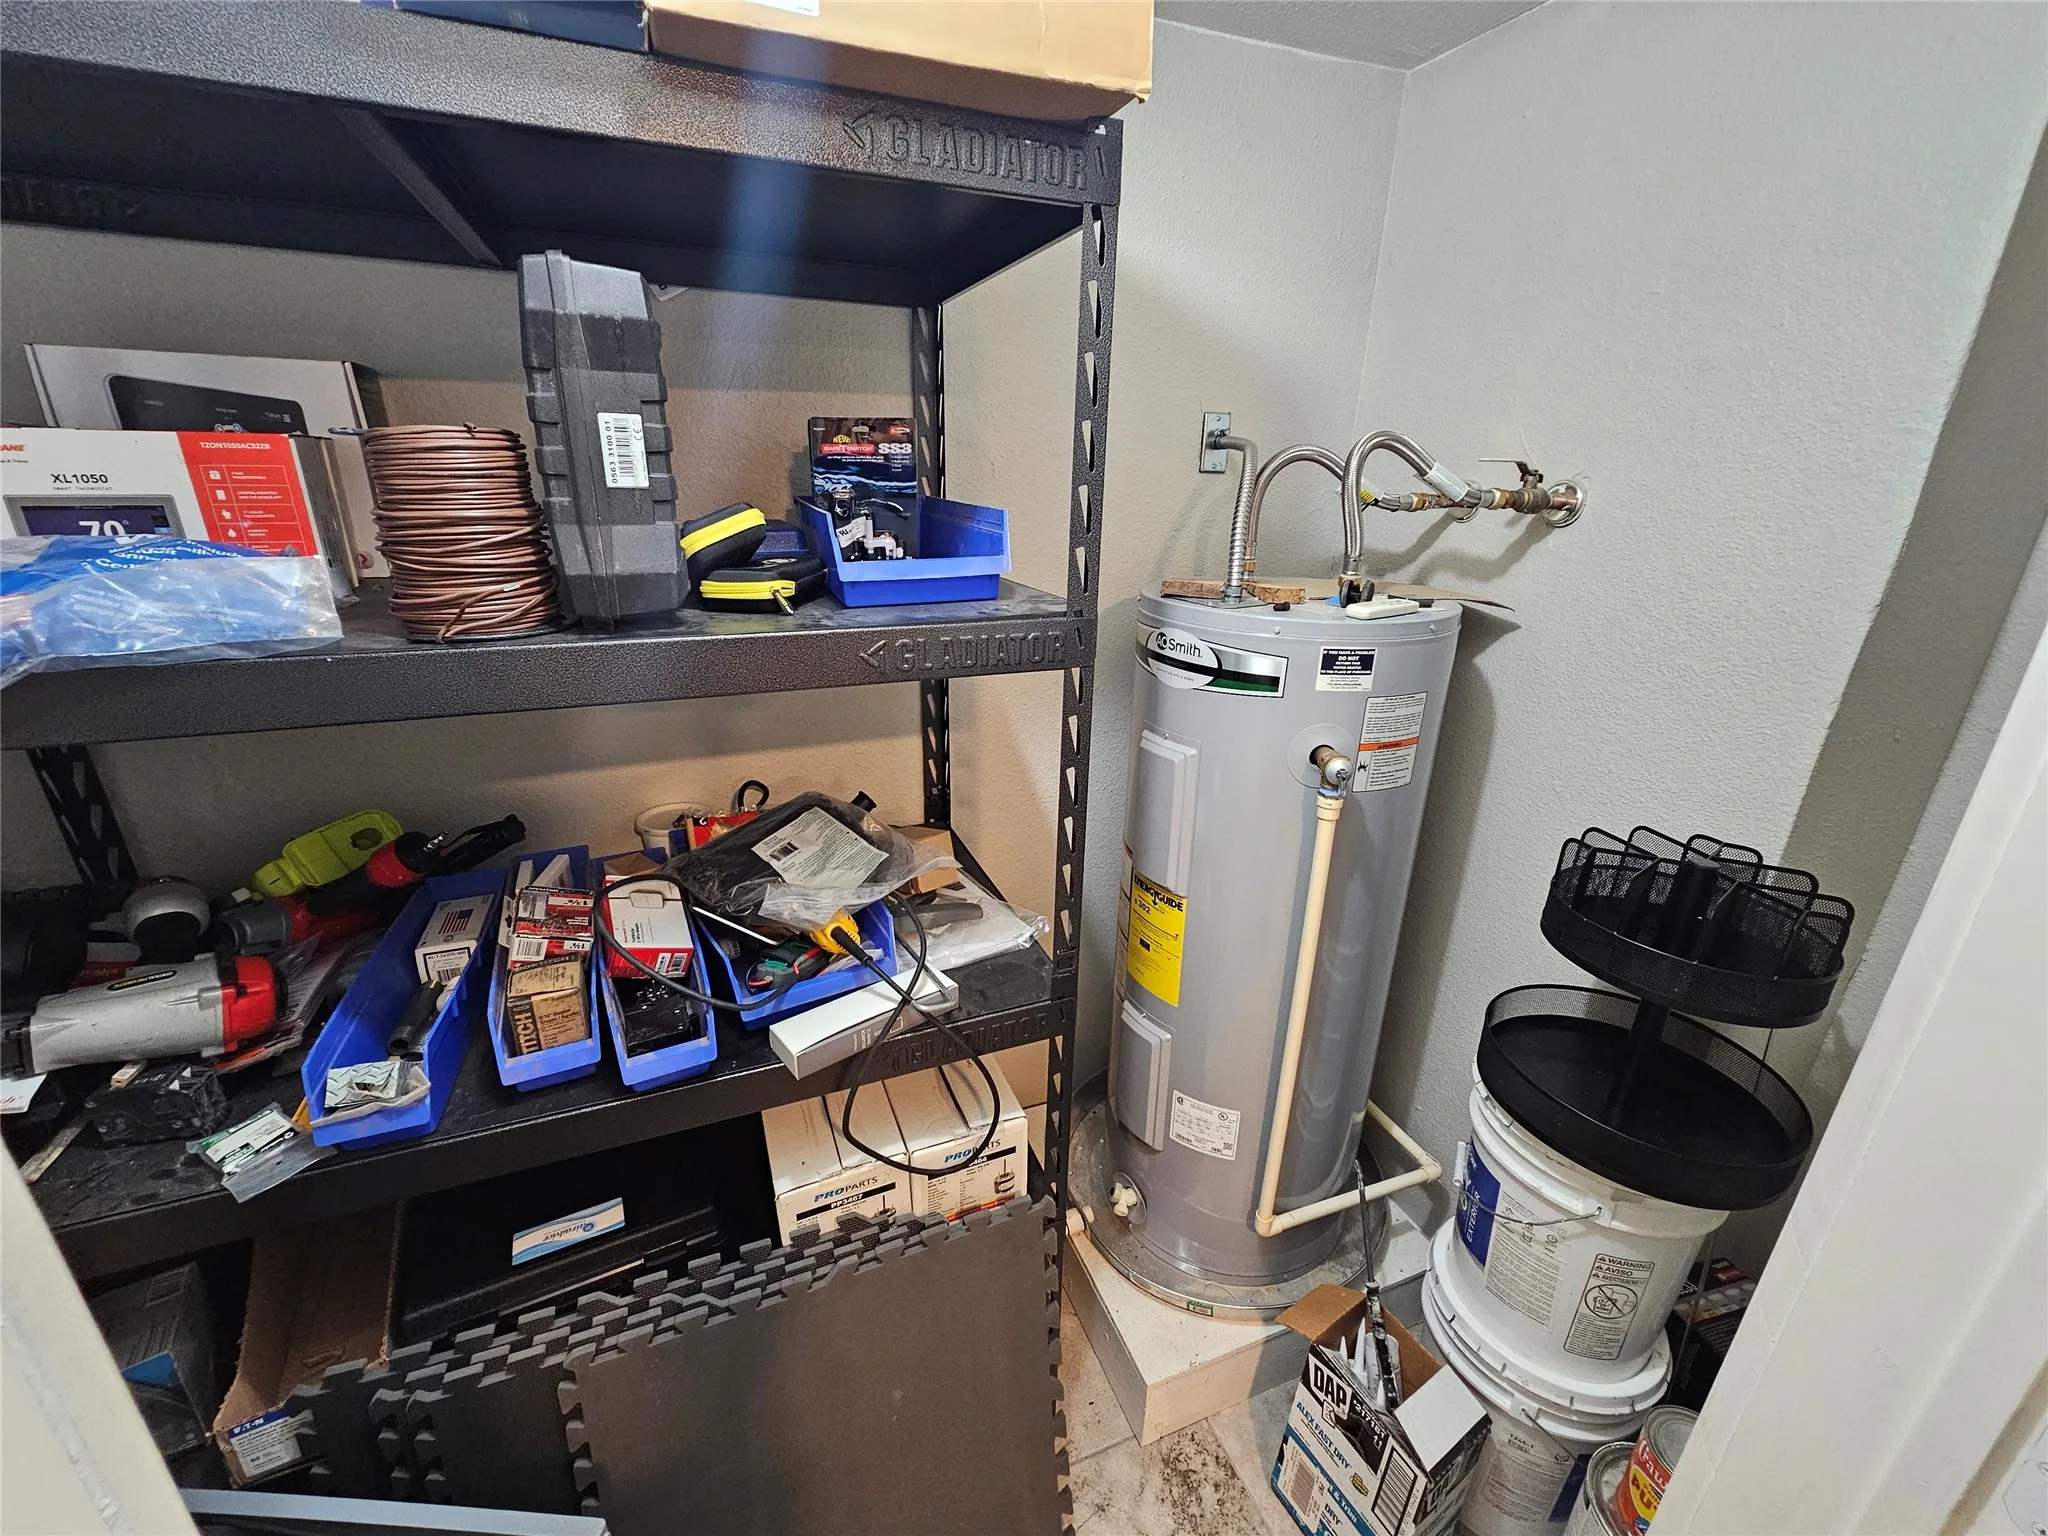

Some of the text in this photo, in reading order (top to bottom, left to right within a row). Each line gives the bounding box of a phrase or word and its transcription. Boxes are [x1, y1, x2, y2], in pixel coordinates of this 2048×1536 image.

[884, 115, 1087, 190] GLADIATOR
[606, 435, 615, 458] 3100
[878, 443, 912, 454] SS3
[50, 473, 108, 484] XL1050
[895, 630, 1066, 672] GLADIATOR
[814, 1176, 878, 1203] PROPARTS
[1604, 1267, 1634, 1277] AVISO
[1608, 1257, 1652, 1269] WARNING
[1313, 1362, 1347, 1410] DAP
[1296, 1402, 1315, 1426] ALEX
[1314, 1423, 1334, 1448] FAST
[1340, 1500, 1358, 1524] Trim
